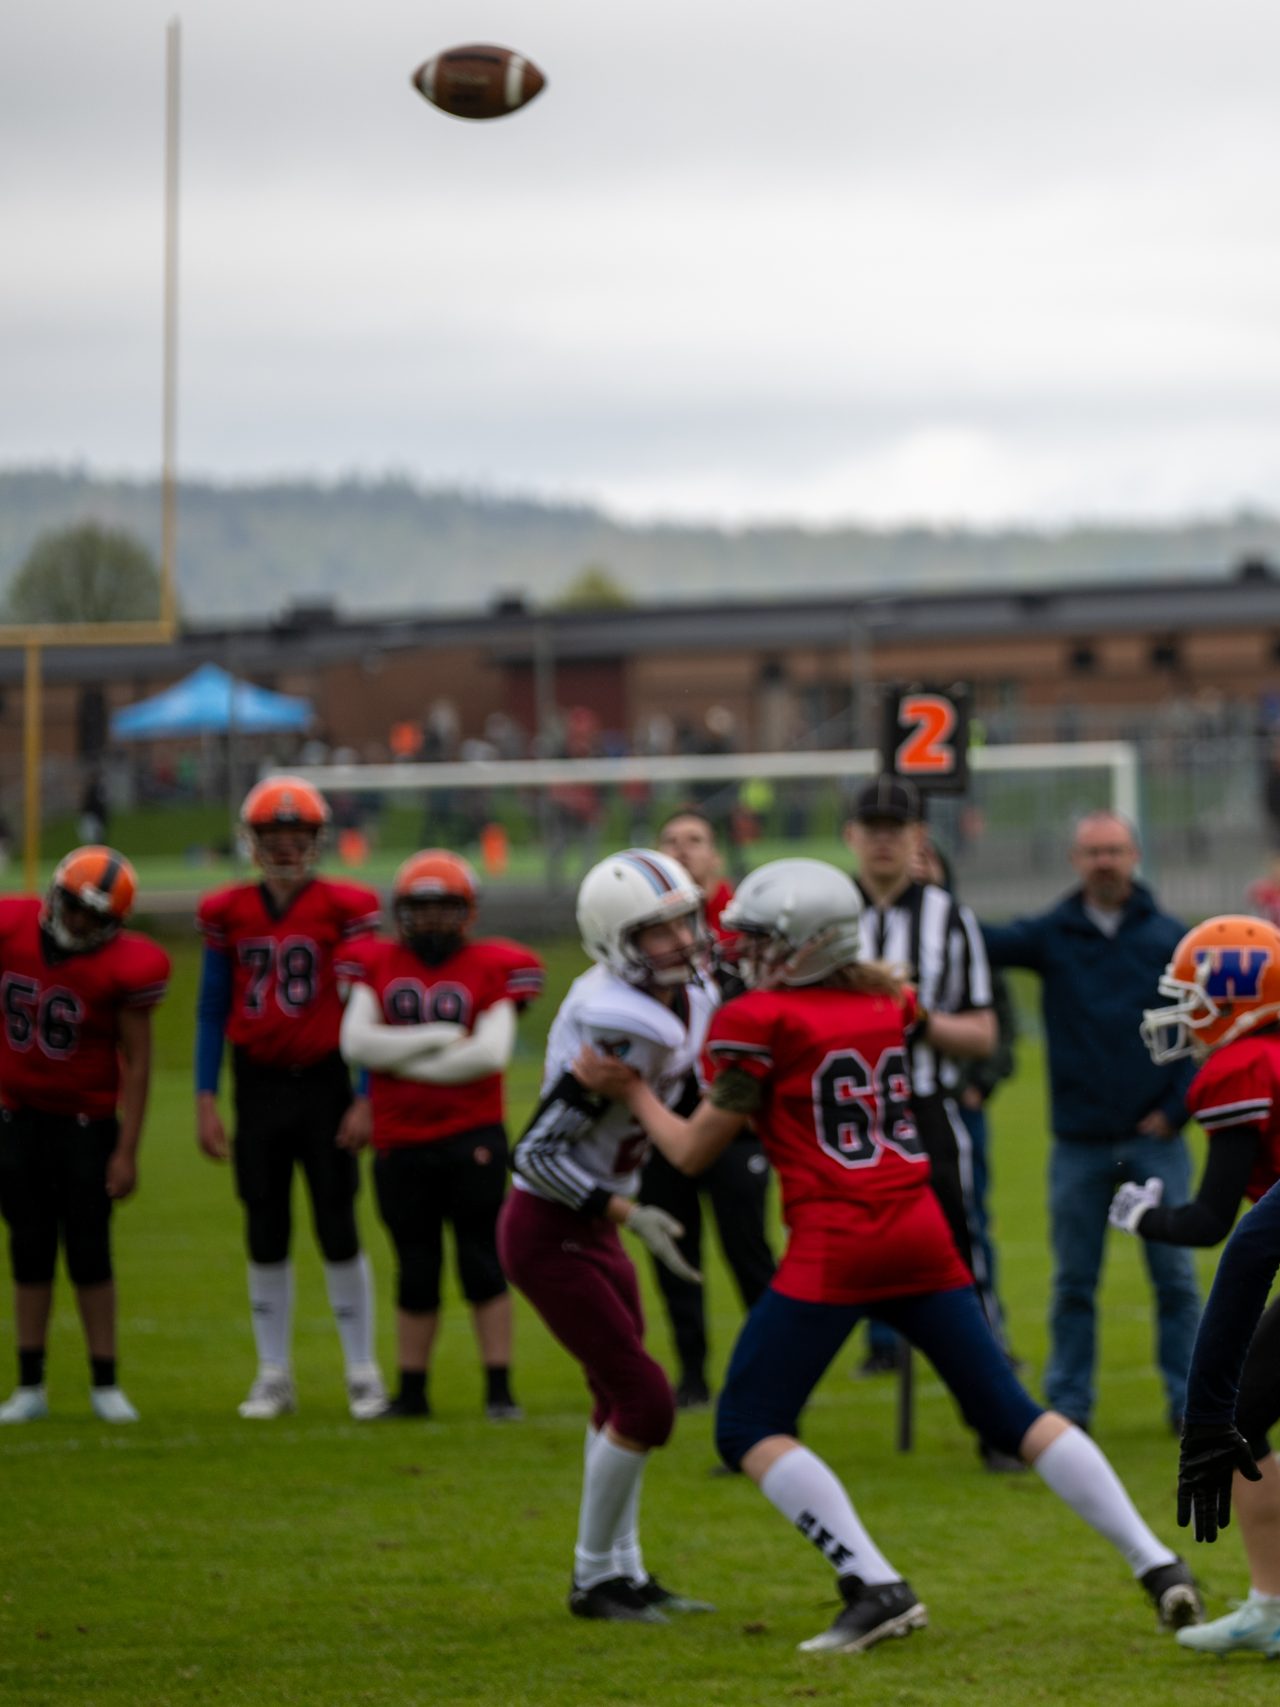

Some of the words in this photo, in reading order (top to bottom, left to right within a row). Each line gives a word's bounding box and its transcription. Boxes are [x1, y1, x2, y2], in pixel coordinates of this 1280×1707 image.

[896, 695, 957, 774] 2
[238, 935, 319, 1018] 78
[1193, 946, 1272, 1002] W
[2, 971, 84, 1060] 56
